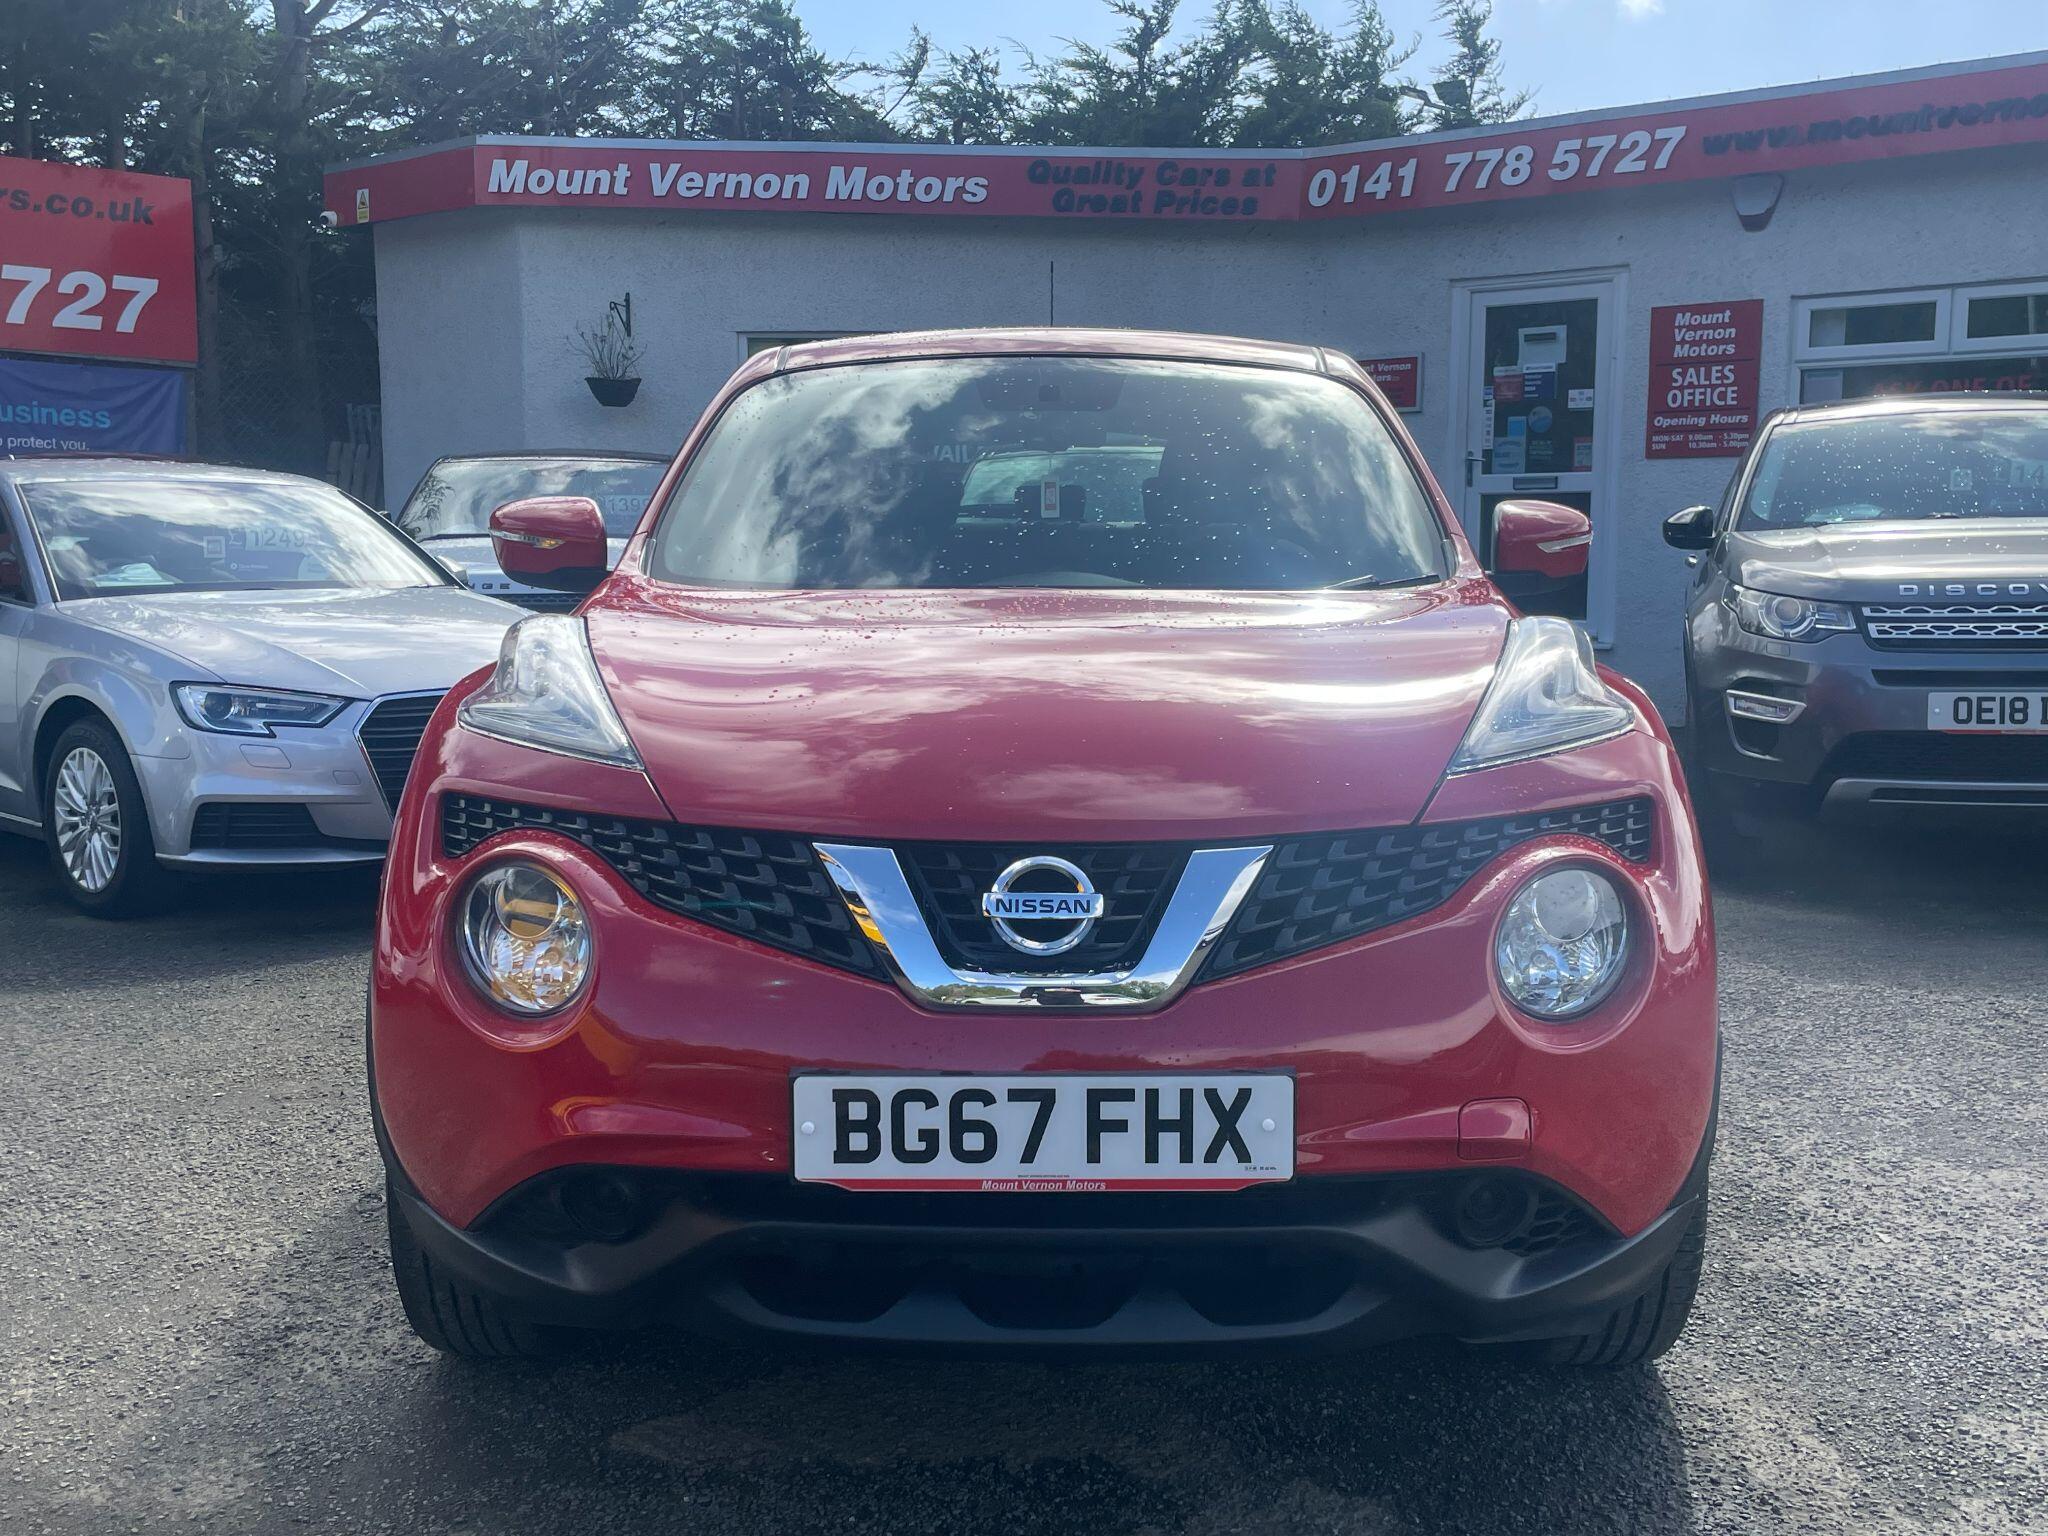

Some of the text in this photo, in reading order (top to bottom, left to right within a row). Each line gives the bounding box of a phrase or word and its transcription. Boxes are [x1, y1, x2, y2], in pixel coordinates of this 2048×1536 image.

[1027, 159, 1277, 189] Quality Cars at
[1308, 125, 1687, 207] 0141 778 5727
[488, 160, 989, 203] Mount Vernon Motors
[1052, 187, 1258, 215] Great Prices
[1674, 309, 1731, 326] Mount
[1674, 328, 1736, 341] Vernon
[1673, 343, 1736, 358] Motors
[1378, 363, 1411, 372] Vernon
[1672, 365, 1735, 387] SALES
[1667, 387, 1738, 408] OFFICE
[1654, 414, 1748, 428] Opening Hours
[7, 436, 57, 450] protect
[1953, 696, 2029, 725] OE18
[995, 898, 1090, 913] NISSAN
[832, 1088, 1253, 1164] BG67 FHX
[981, 1180, 1106, 1190] Mount Vernon Motors
